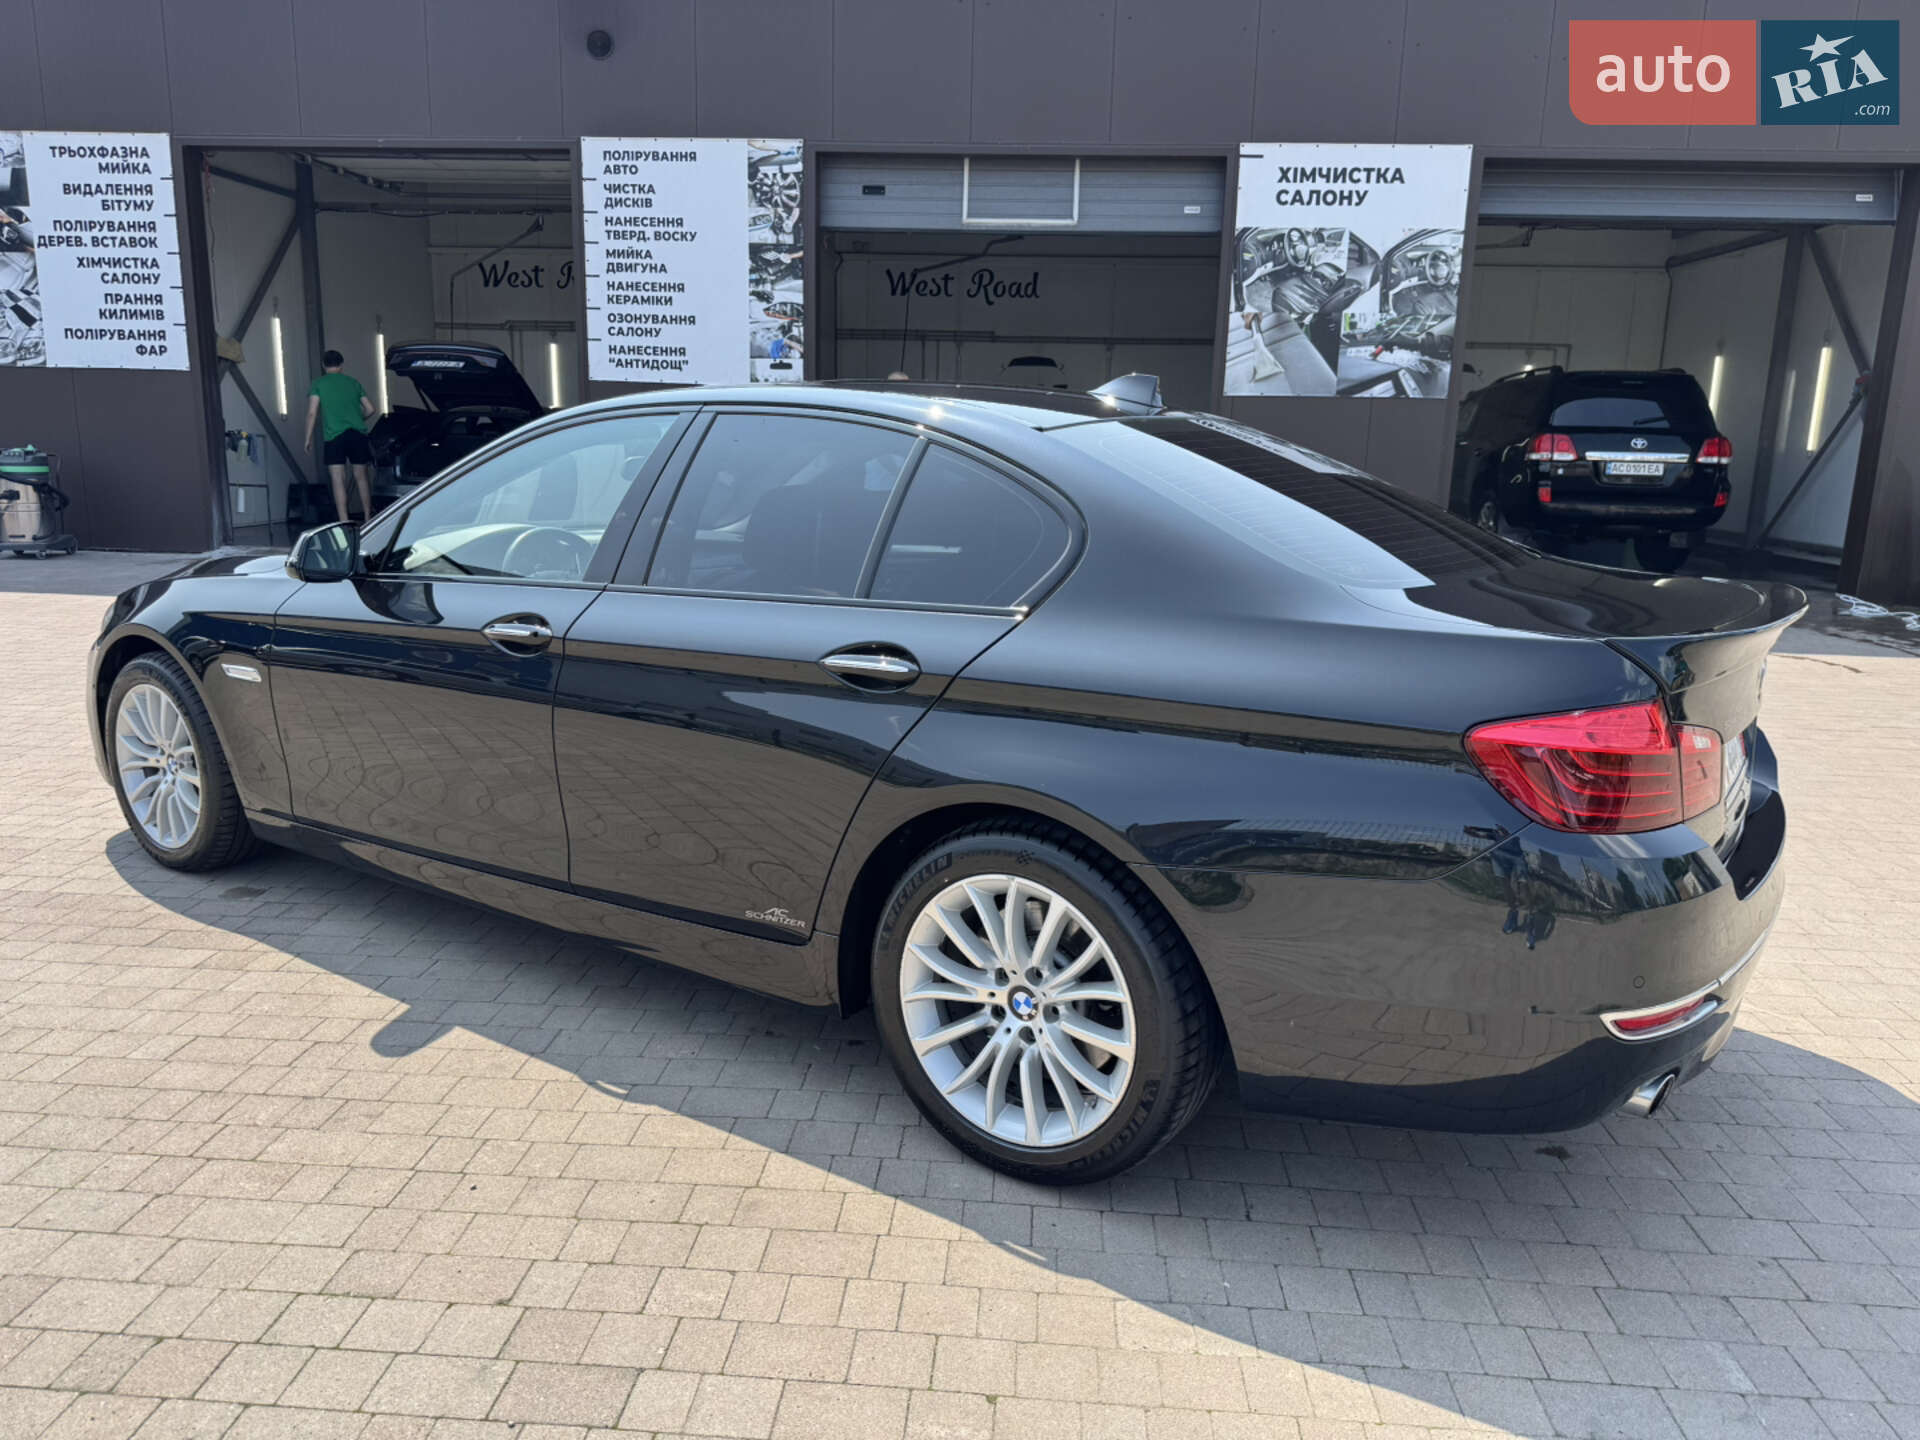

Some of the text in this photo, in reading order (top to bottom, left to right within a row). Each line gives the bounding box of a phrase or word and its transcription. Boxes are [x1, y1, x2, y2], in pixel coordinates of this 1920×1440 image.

[48, 145, 150, 159] ТРЬОХФАЗНА
[602, 150, 697, 162] ПОЛІРУВАННЯ
[97, 159, 152, 175] МИЙКА
[603, 164, 639, 176] АВТО
[1277, 166, 1405, 185] ХІМЧИСТКА
[62, 183, 154, 198] ВИДАЛЕННЯ
[603, 183, 656, 195] ЧИСТКА
[603, 197, 653, 210] ДИСКІВ
[1275, 188, 1369, 207] САЛОНУ
[100, 199, 154, 212] БІТУМУ
[52, 219, 157, 233] ПОЛІРУВАННЯ
[604, 216, 684, 228] НАНЕСЕННЯ
[36, 234, 159, 249] ДЕРЕВ. ВСТАВОК
[604, 229, 698, 243] ТВЕРД. ВОСКУ
[605, 246, 653, 260] МИЙКА
[76, 256, 160, 270] ХІМЧИСТКА
[605, 262, 668, 275] ДВИГУНА
[100, 271, 161, 285] САЛОНУ
[478, 260, 544, 288] West
[606, 281, 685, 293] НАНЕСЕННЯ
[885, 268, 1040, 306] West Road
[103, 292, 164, 306] ПРАННЯ
[606, 294, 673, 306] КЕРАМІКИ
[98, 308, 165, 321] КИЛИМІВ
[607, 312, 696, 326] ОЗОНУВАННЯ
[63, 327, 167, 342] ПОЛІРУВАННЯ
[607, 326, 662, 338] САЛОНУ
[135, 343, 168, 357] ФАР
[608, 345, 687, 357] НАНЕСЕННЯ
[764, 907, 789, 918] AC
